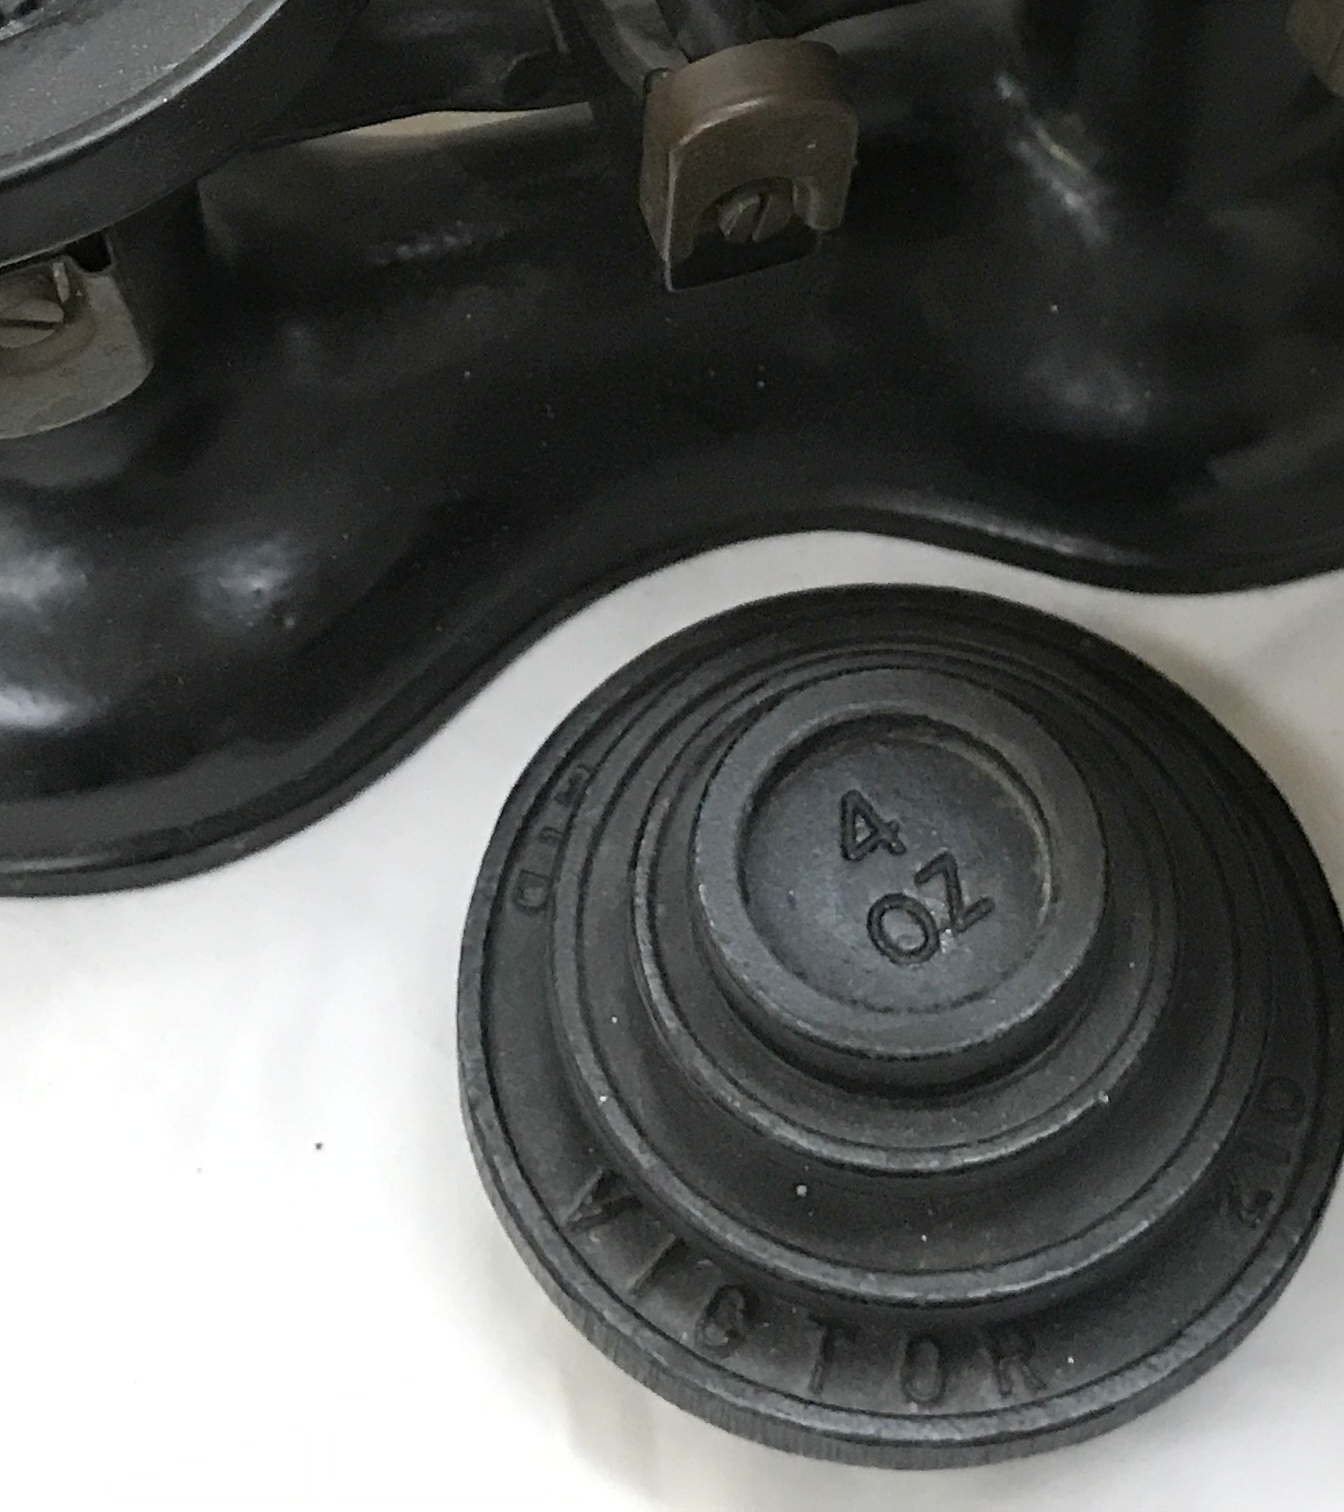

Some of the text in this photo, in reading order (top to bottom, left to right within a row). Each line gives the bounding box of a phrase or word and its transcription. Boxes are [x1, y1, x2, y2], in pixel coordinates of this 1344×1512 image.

[840, 789, 906, 862] 4
[866, 850, 996, 966] OZ
[564, 1166, 1048, 1405] VICTOR
